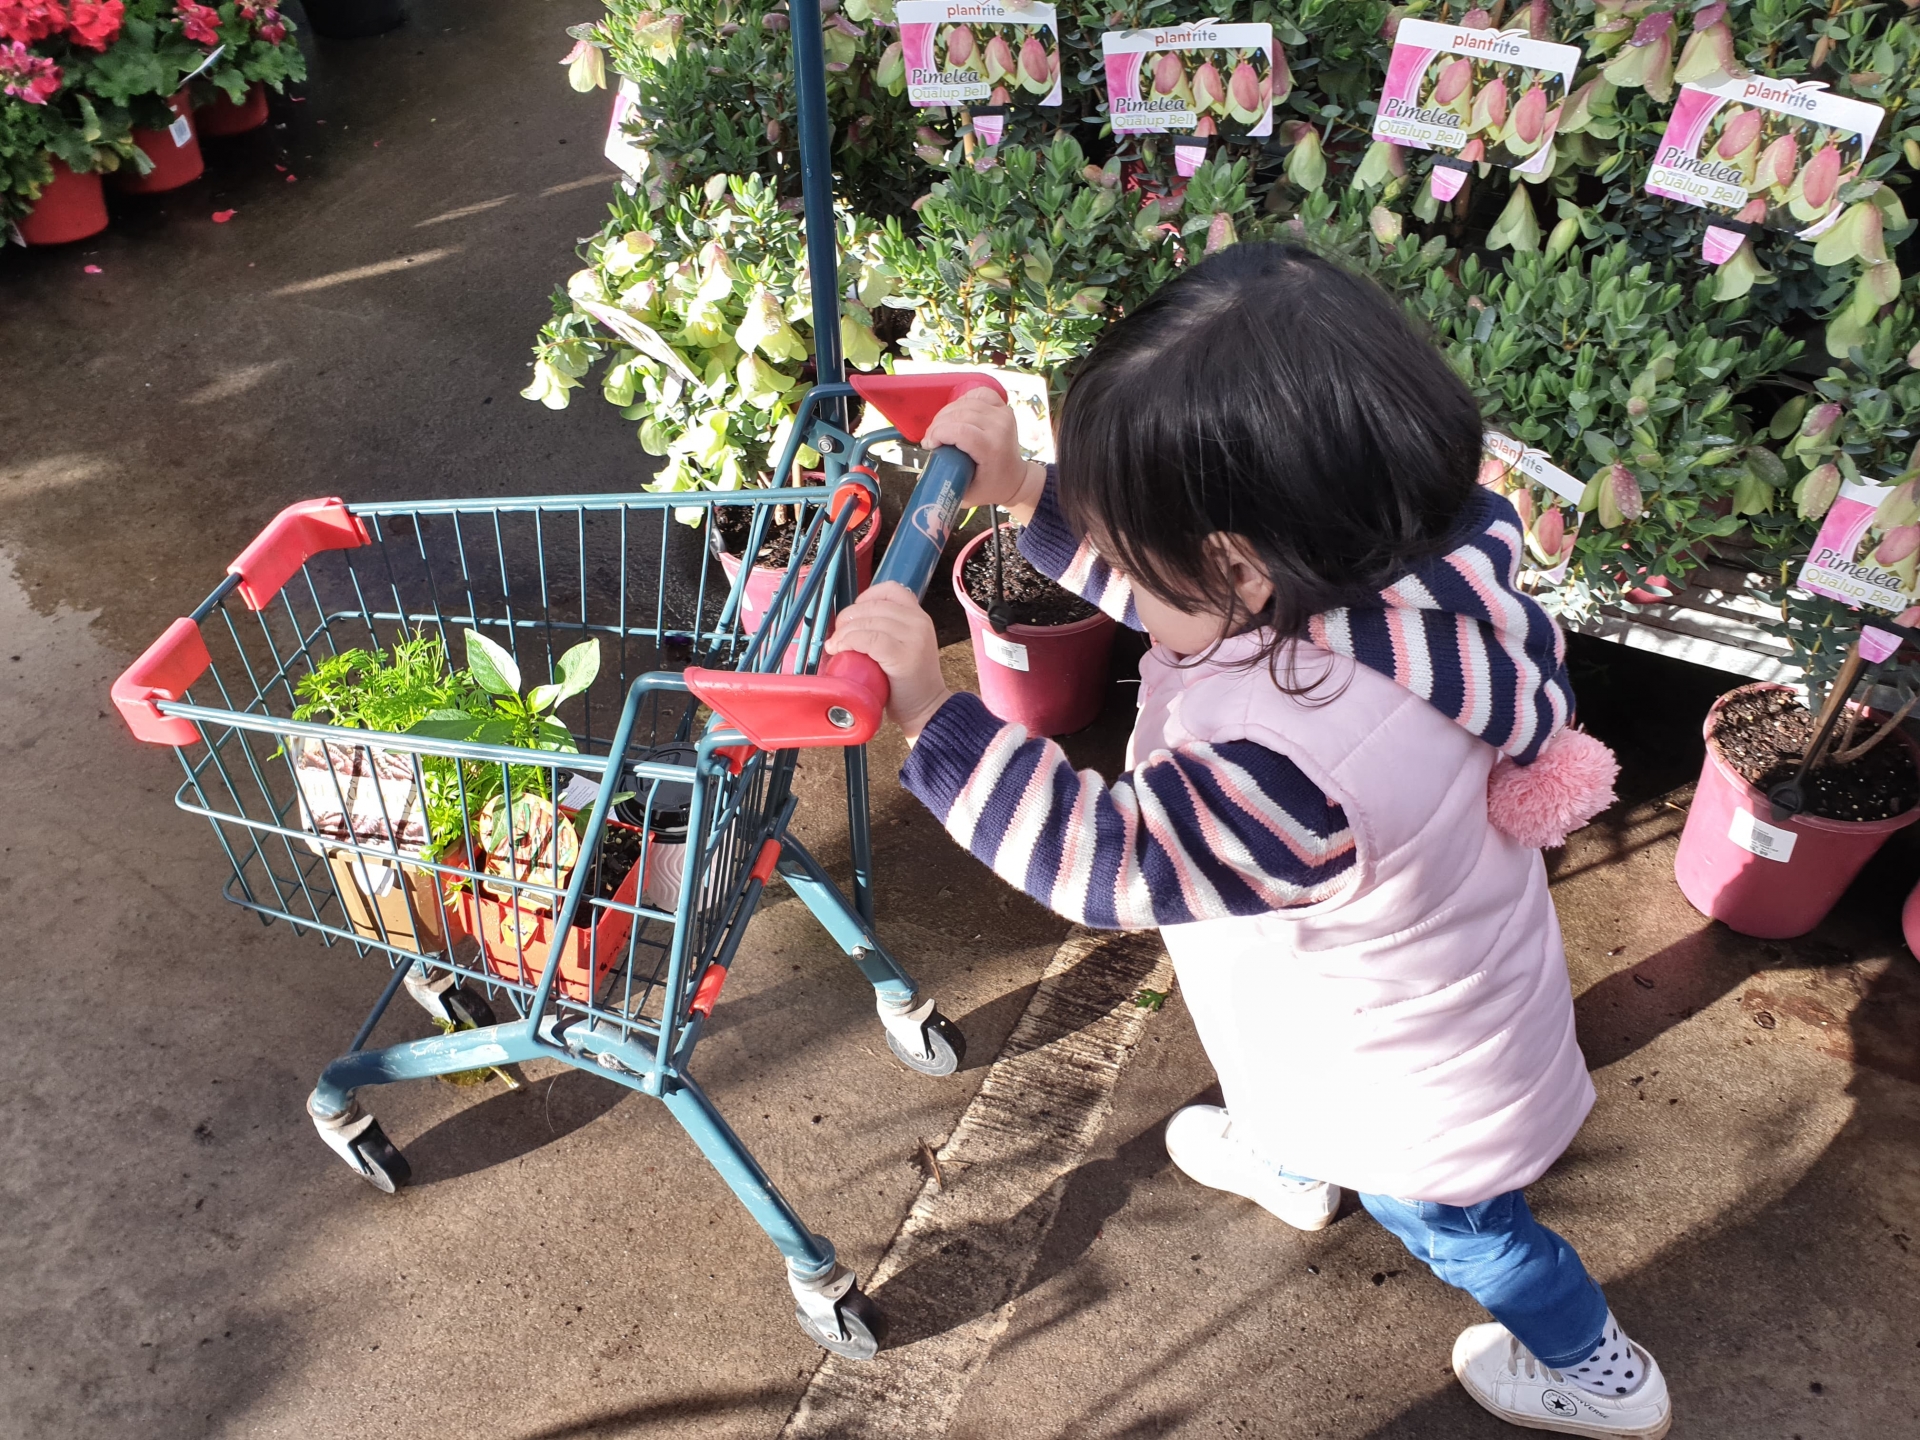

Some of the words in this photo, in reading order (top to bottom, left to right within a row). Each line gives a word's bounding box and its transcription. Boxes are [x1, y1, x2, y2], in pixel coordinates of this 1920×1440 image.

[947, 4, 1005, 18] plantrite
[1155, 30, 1217, 47] plantrite
[1452, 33, 1520, 56] plantrite
[912, 69, 979, 84] Pimelea
[912, 87, 960, 100] Qualup
[963, 84, 988, 97] Bell
[1115, 97, 1185, 112] Pimelea
[1743, 82, 1817, 110] plantrite
[1115, 115, 1165, 127] Qualup
[1168, 114, 1194, 125] Bell
[1384, 98, 1461, 127] Pimelea
[1378, 119, 1432, 141] Qualup
[1435, 129, 1465, 146] Bell
[1660, 147, 1743, 183] Pimelea
[1652, 170, 1709, 197] Qualup
[1711, 186, 1745, 205] Bell
[1814, 548, 1902, 589] Pimelea
[1806, 568, 1866, 597] Qualup
[1868, 589, 1905, 609] Bell
[1568, 1392, 1609, 1419] CONVERSE
